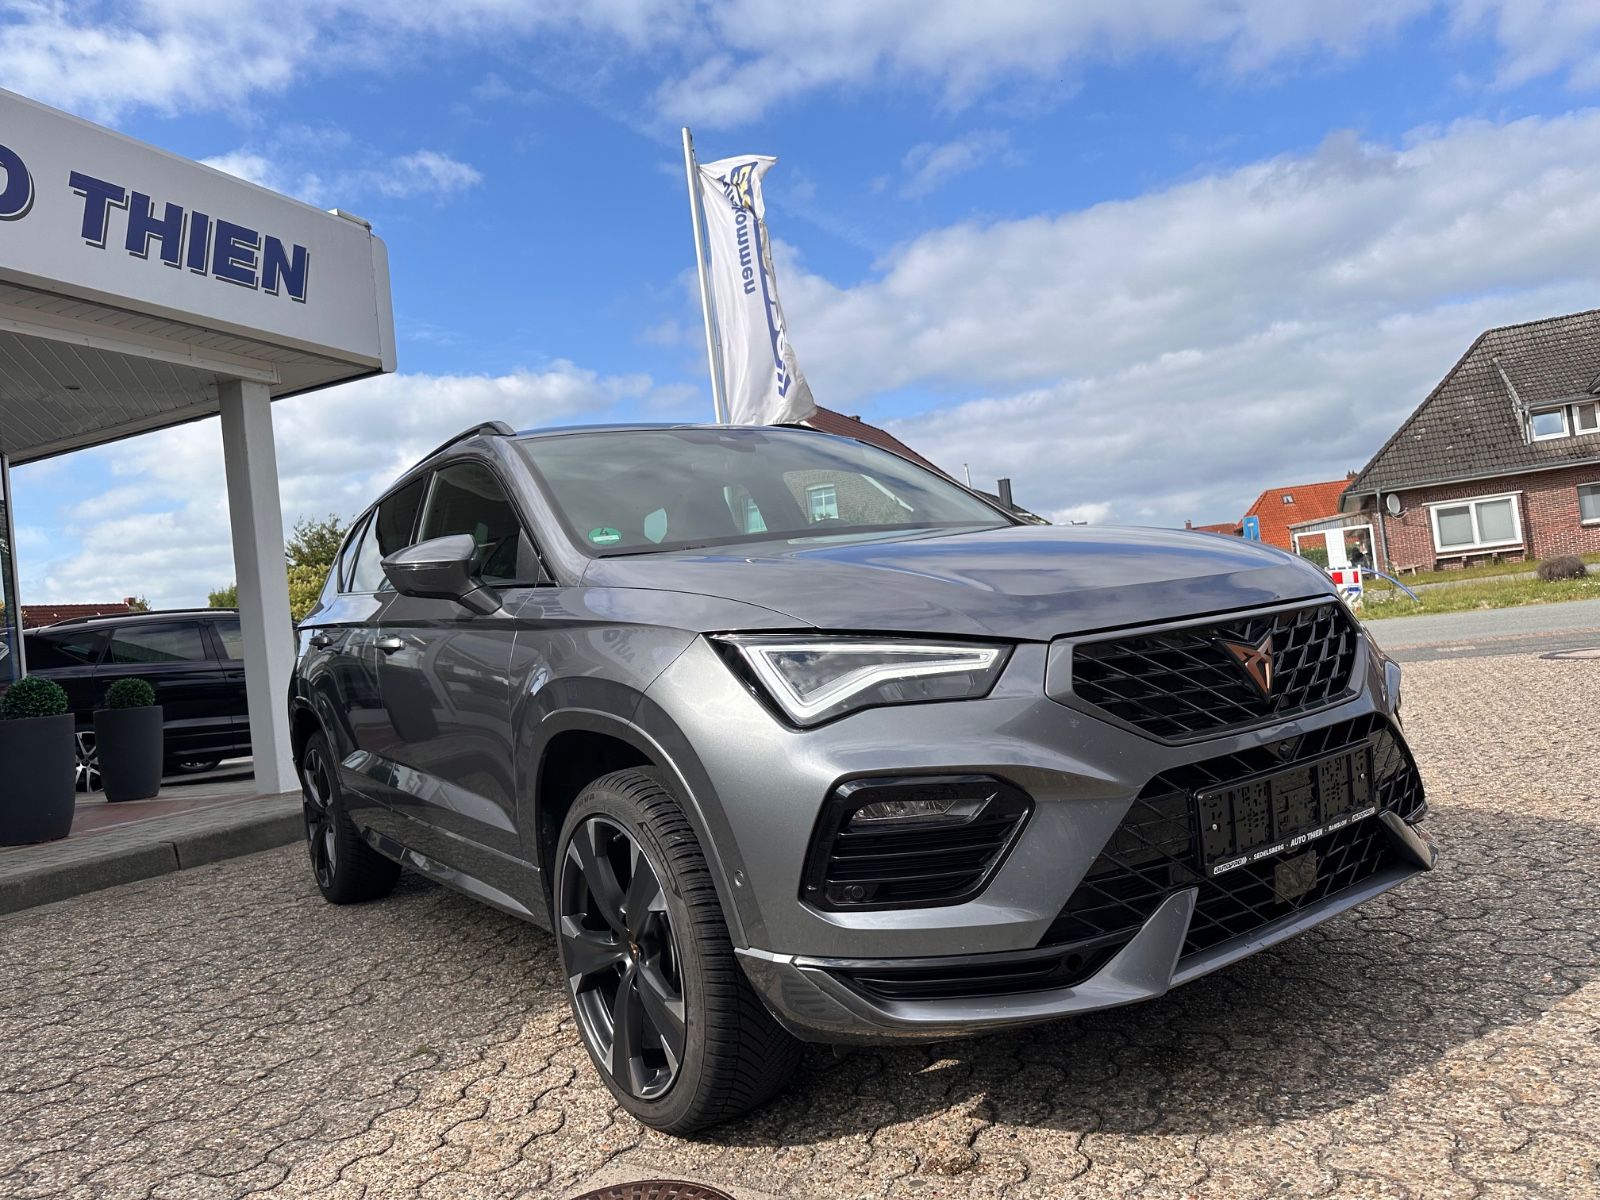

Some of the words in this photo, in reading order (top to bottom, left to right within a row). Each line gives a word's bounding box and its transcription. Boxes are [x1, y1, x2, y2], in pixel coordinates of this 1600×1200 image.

[69, 171, 310, 303] THIEN
[1290, 834, 1307, 847] AUTO
[1307, 828, 1324, 841] THIEN
